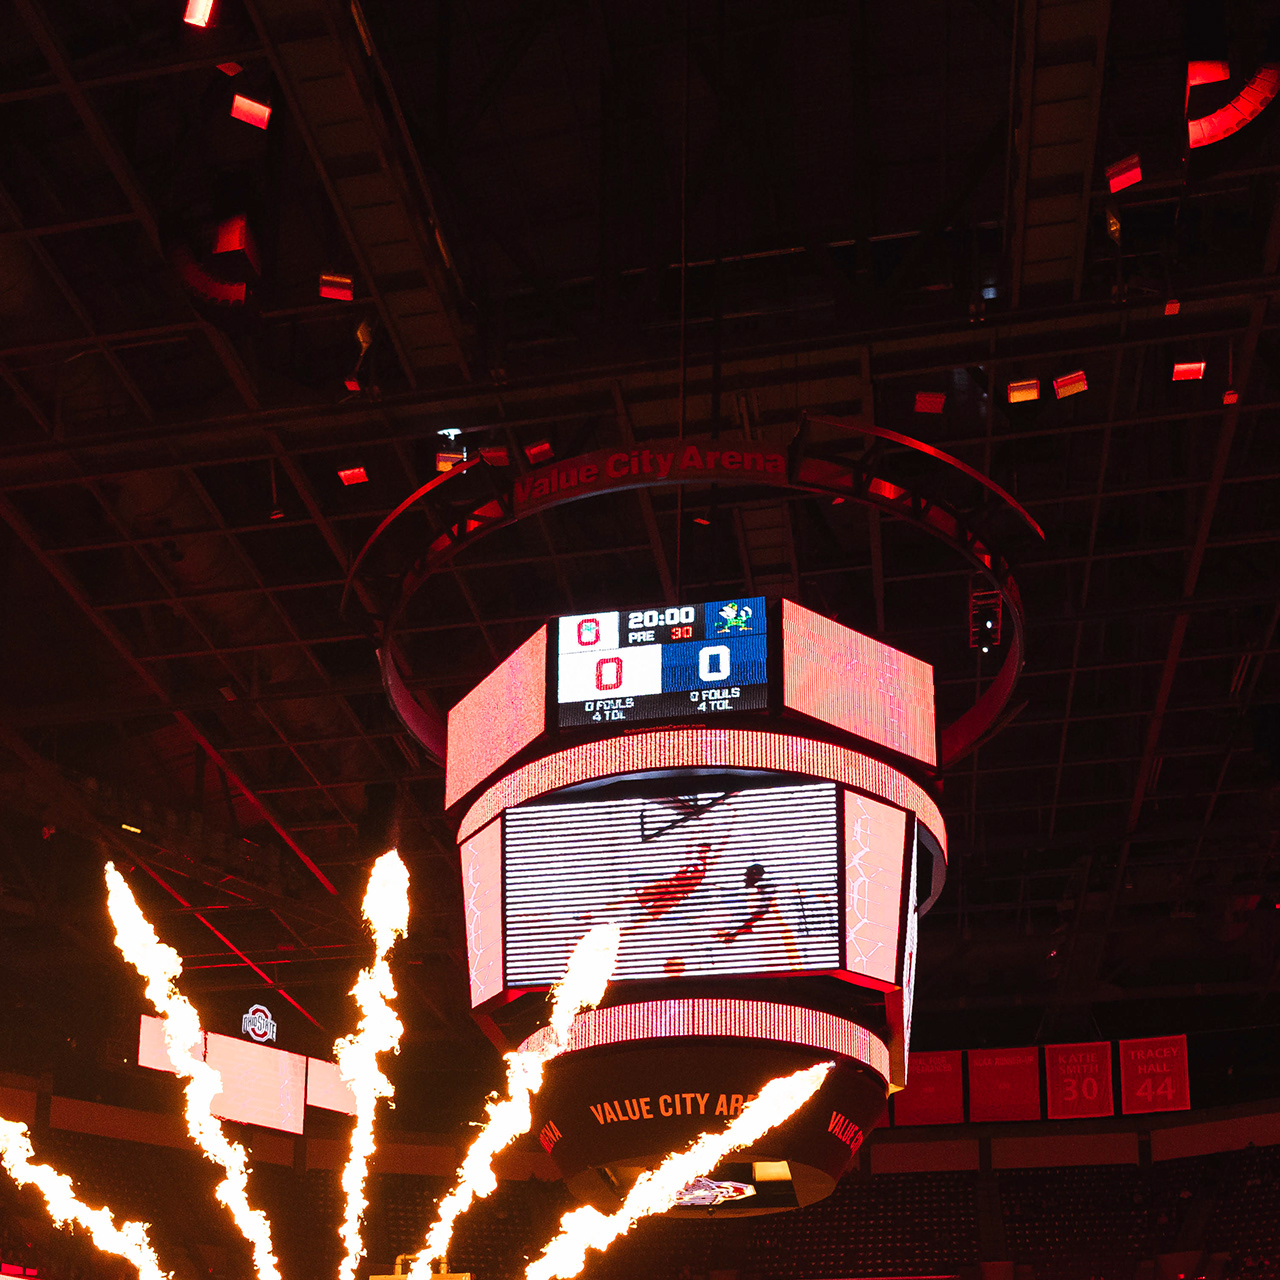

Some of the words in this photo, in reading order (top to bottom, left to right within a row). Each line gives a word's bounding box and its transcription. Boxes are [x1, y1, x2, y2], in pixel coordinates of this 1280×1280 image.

[514, 463, 599, 503] Value
[606, 447, 674, 479] City
[680, 445, 786, 474] Arena
[628, 607, 695, 631] 20:00
[628, 631, 655, 644] PRE
[670, 626, 693, 640] 30
[595, 656, 623, 691] 0
[698, 645, 731, 682] 0
[596, 697, 635, 711] FOULS
[701, 687, 740, 701] FOULS
[592, 711, 602, 722] 4
[696, 702, 707, 712] 4
[1058, 1052, 1098, 1064] KATIE
[1129, 1046, 1179, 1061] TRACEY
[1137, 1061, 1170, 1074] HALL
[1062, 1076, 1099, 1101] 30
[1135, 1076, 1178, 1102] 44
[589, 1096, 654, 1126] VALUE
[659, 1093, 710, 1118] CITY
[827, 1110, 859, 1146] VALUE
